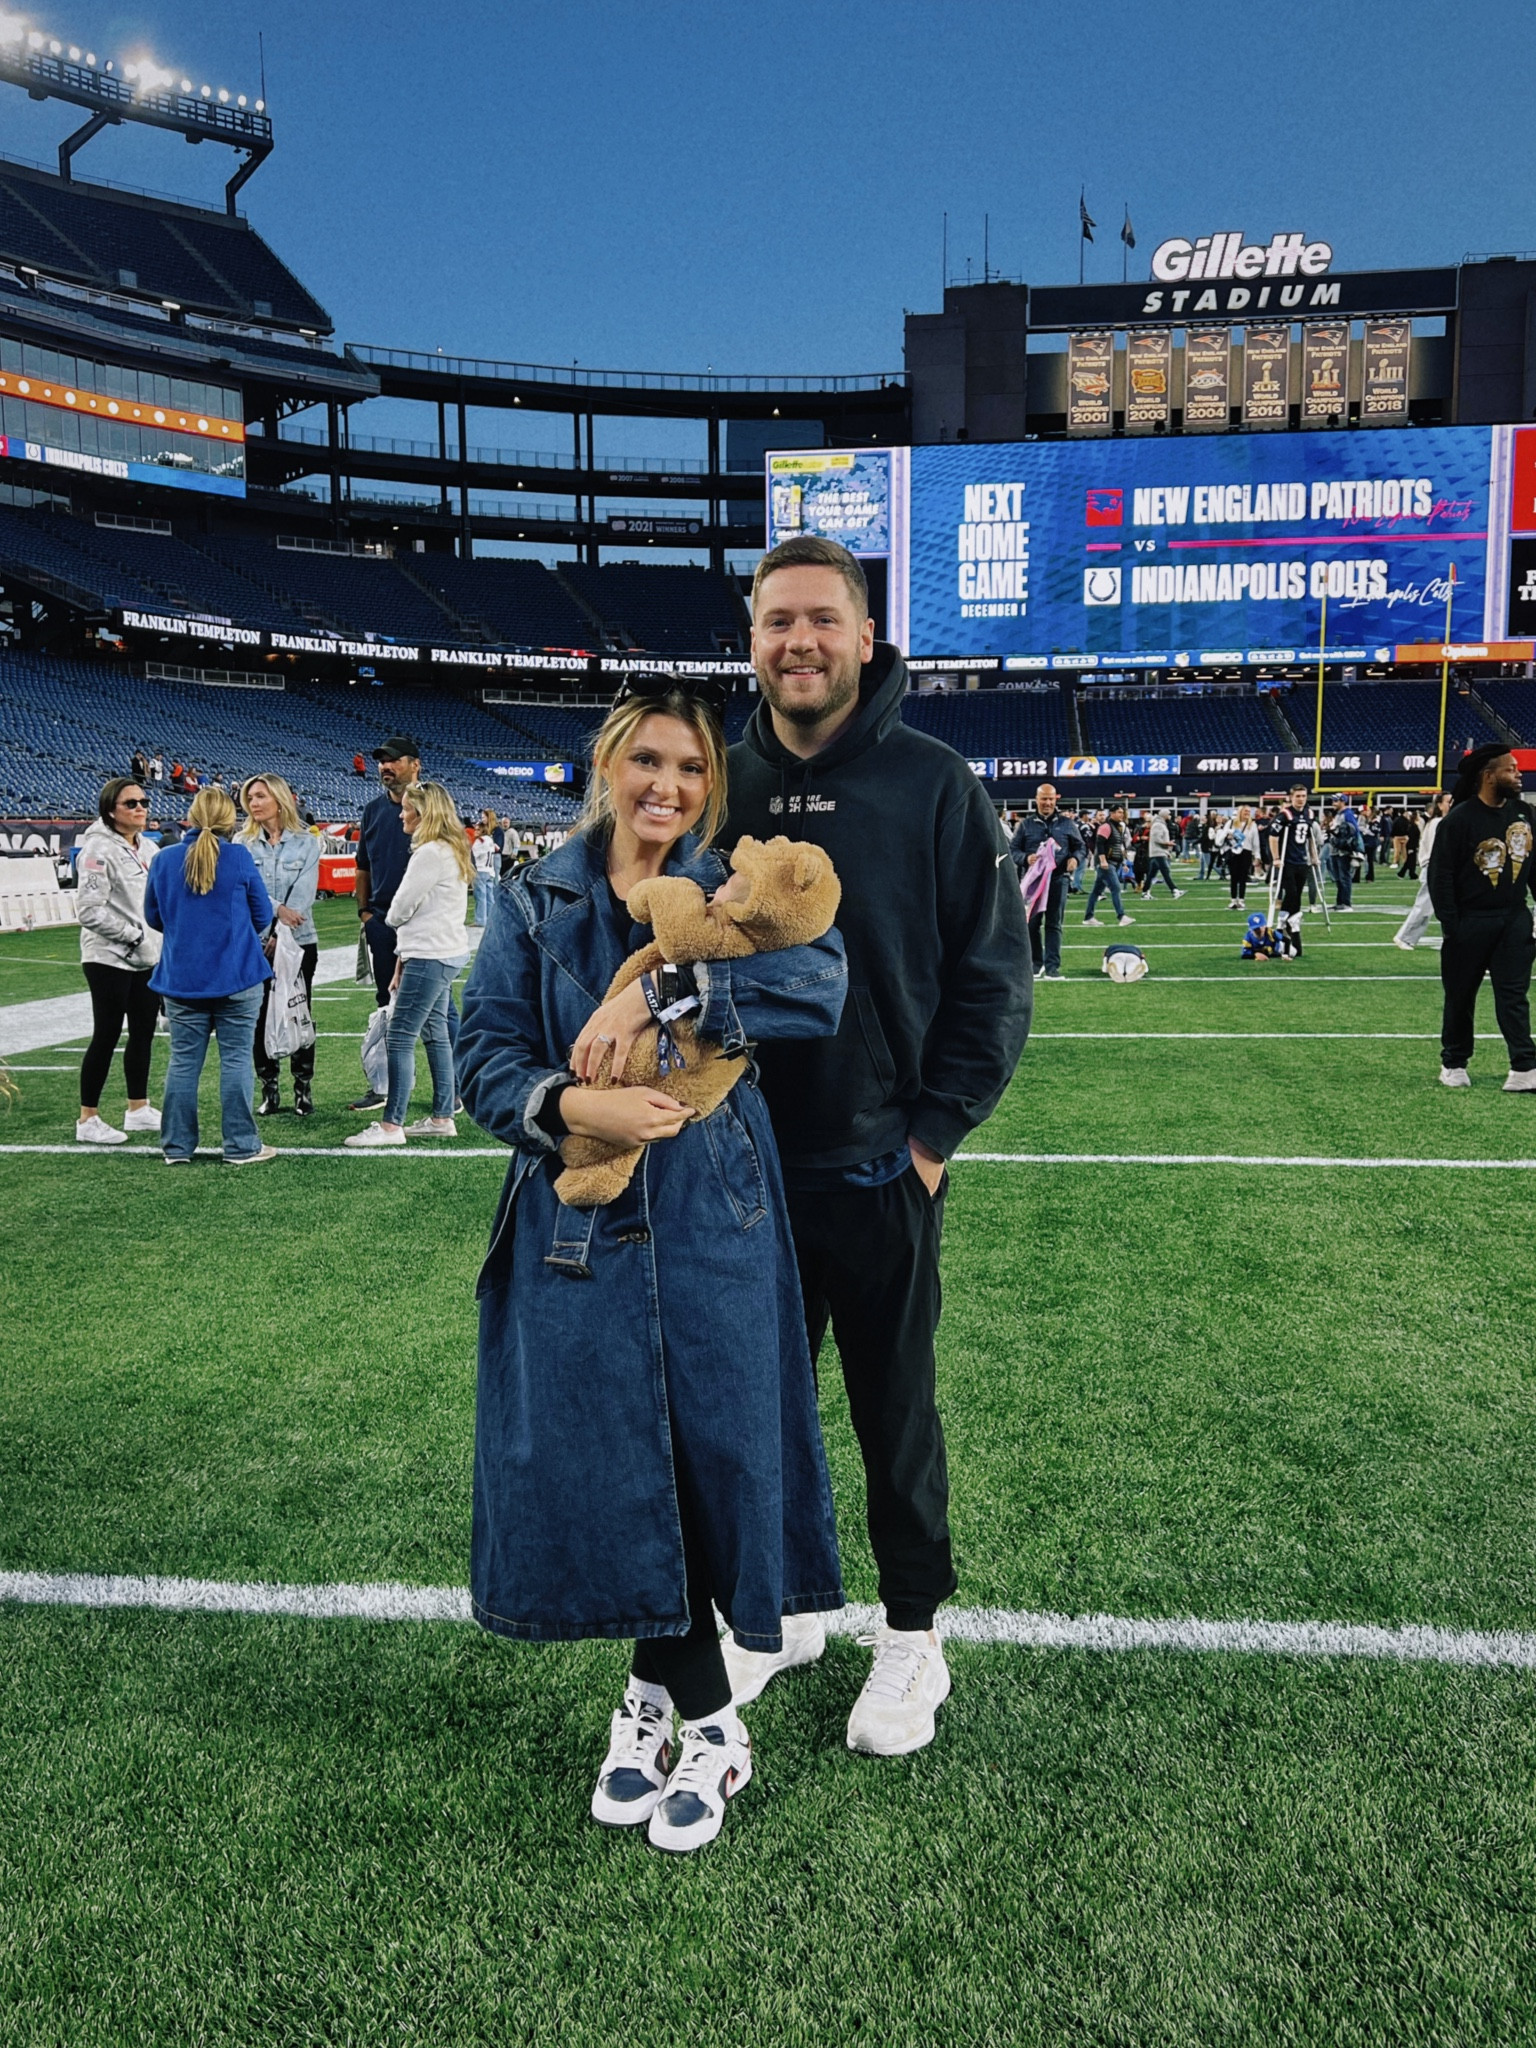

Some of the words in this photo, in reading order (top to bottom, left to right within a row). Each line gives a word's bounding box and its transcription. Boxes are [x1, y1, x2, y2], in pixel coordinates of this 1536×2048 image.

[1152, 232, 1334, 281] Gillette
[1142, 282, 1342, 314] STADIUM
[1187, 407, 1225, 418] 2004
[1248, 406, 1283, 417] 2014
[1307, 404, 1343, 414] 2016
[1367, 401, 1403, 412] 2018
[1073, 412, 1108, 423] 2001
[1129, 409, 1167, 420] 2003
[818, 492, 840, 503] THE
[841, 491, 870, 503] BEST
[964, 483, 1026, 522] NEXT
[1133, 486, 1190, 526] NEW
[1194, 483, 1307, 524] ENGLAND
[1310, 479, 1433, 519] PATRIOTS
[808, 505, 841, 517] YOUR
[844, 503, 879, 515] GAME
[628, 520, 653, 532] 2021
[818, 518, 844, 529] CAN
[846, 517, 871, 528] GET
[958, 522, 1030, 561] HOME
[1134, 539, 1157, 553] VS
[958, 562, 1029, 600] GAME
[1132, 562, 1306, 604] INDIANAPOLIS
[1312, 559, 1388, 599] COLTS
[960, 603, 1019, 617] DECEMBER
[122, 610, 188, 635] FRANKLIN
[189, 621, 261, 646] TEMPLETON
[270, 632, 337, 654] FRANKLIN
[339, 641, 419, 661] TEMPLETON
[431, 649, 502, 667] FRANKLIN
[504, 654, 589, 670] TEMPLETON
[600, 658, 674, 673] FRANKLIN
[675, 659, 757, 674] TEMPLETO
[936, 659, 999, 670] TEMPLETON
[1002, 760, 1048, 775] 21:12
[1103, 760, 1134, 773] LAR
[1148, 758, 1169, 772] 28
[1197, 759, 1229, 772] 4TH
[1230, 759, 1241, 771] &
[1241, 758, 1259, 771] 13
[1319, 757, 1335, 769] ON
[1339, 757, 1361, 769] 46
[1403, 756, 1424, 770] QTR
[1424, 755, 1438, 768] 4
[508, 767, 534, 776] GEICO
